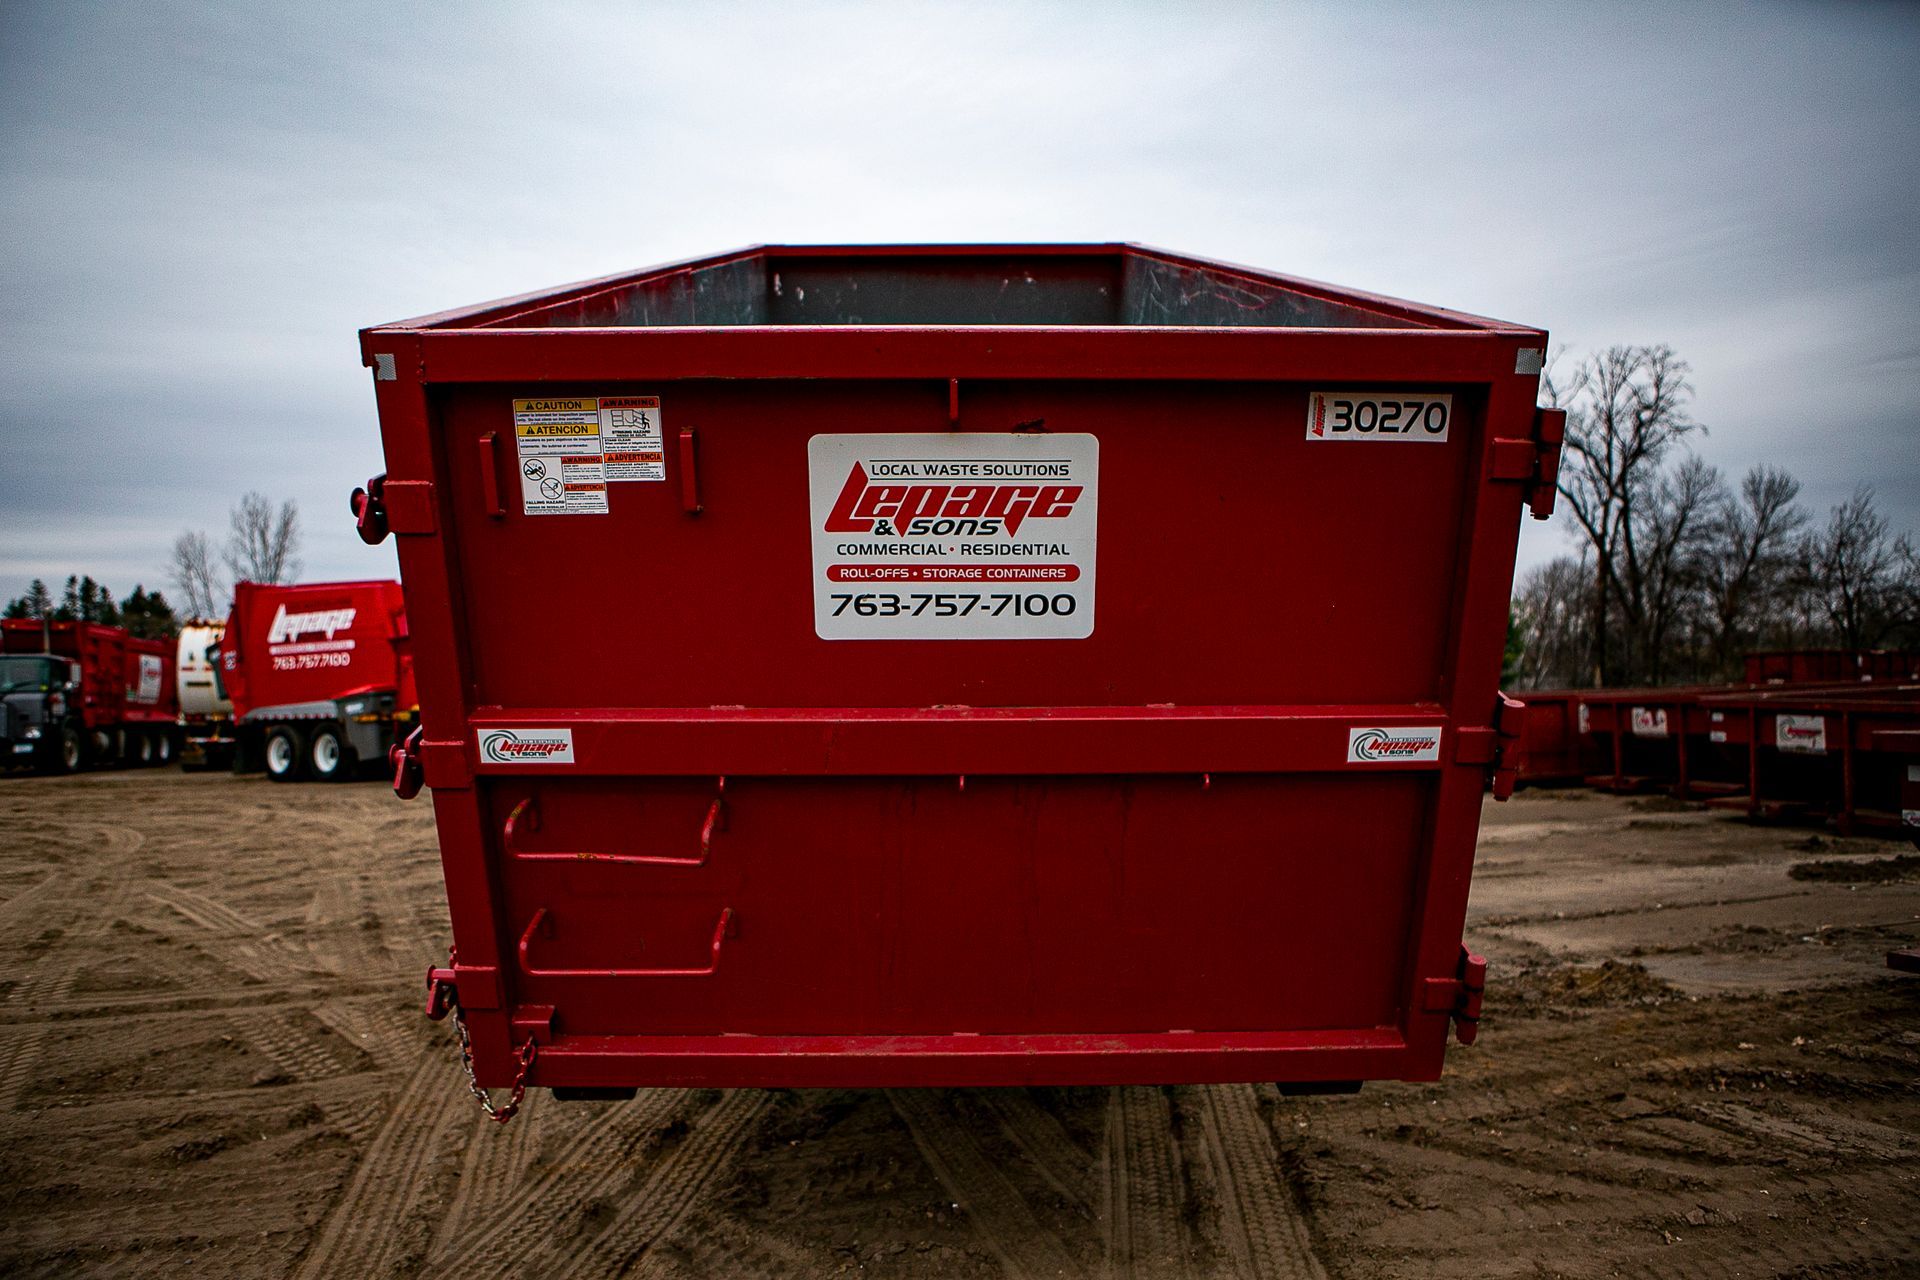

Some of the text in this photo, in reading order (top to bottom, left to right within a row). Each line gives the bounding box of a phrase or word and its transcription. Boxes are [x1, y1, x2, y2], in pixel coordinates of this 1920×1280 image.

[536, 402, 582, 410] CAUTION
[1332, 400, 1448, 434] 30270
[536, 426, 588, 434] ATENCION
[615, 453, 661, 461] ADVERTENCIA
[872, 464, 1069, 476] LOCAL WASTE SOLUTIONS
[824, 460, 1084, 538] Lepage
[874, 520, 896, 536] &
[836, 544, 1070, 556] COMMERCIAL RESIDENTIAL
[840, 568, 1066, 578] ROLL-OFFS STORAGE CONTAINERS
[830, 594, 1076, 617] 763-757-7100
